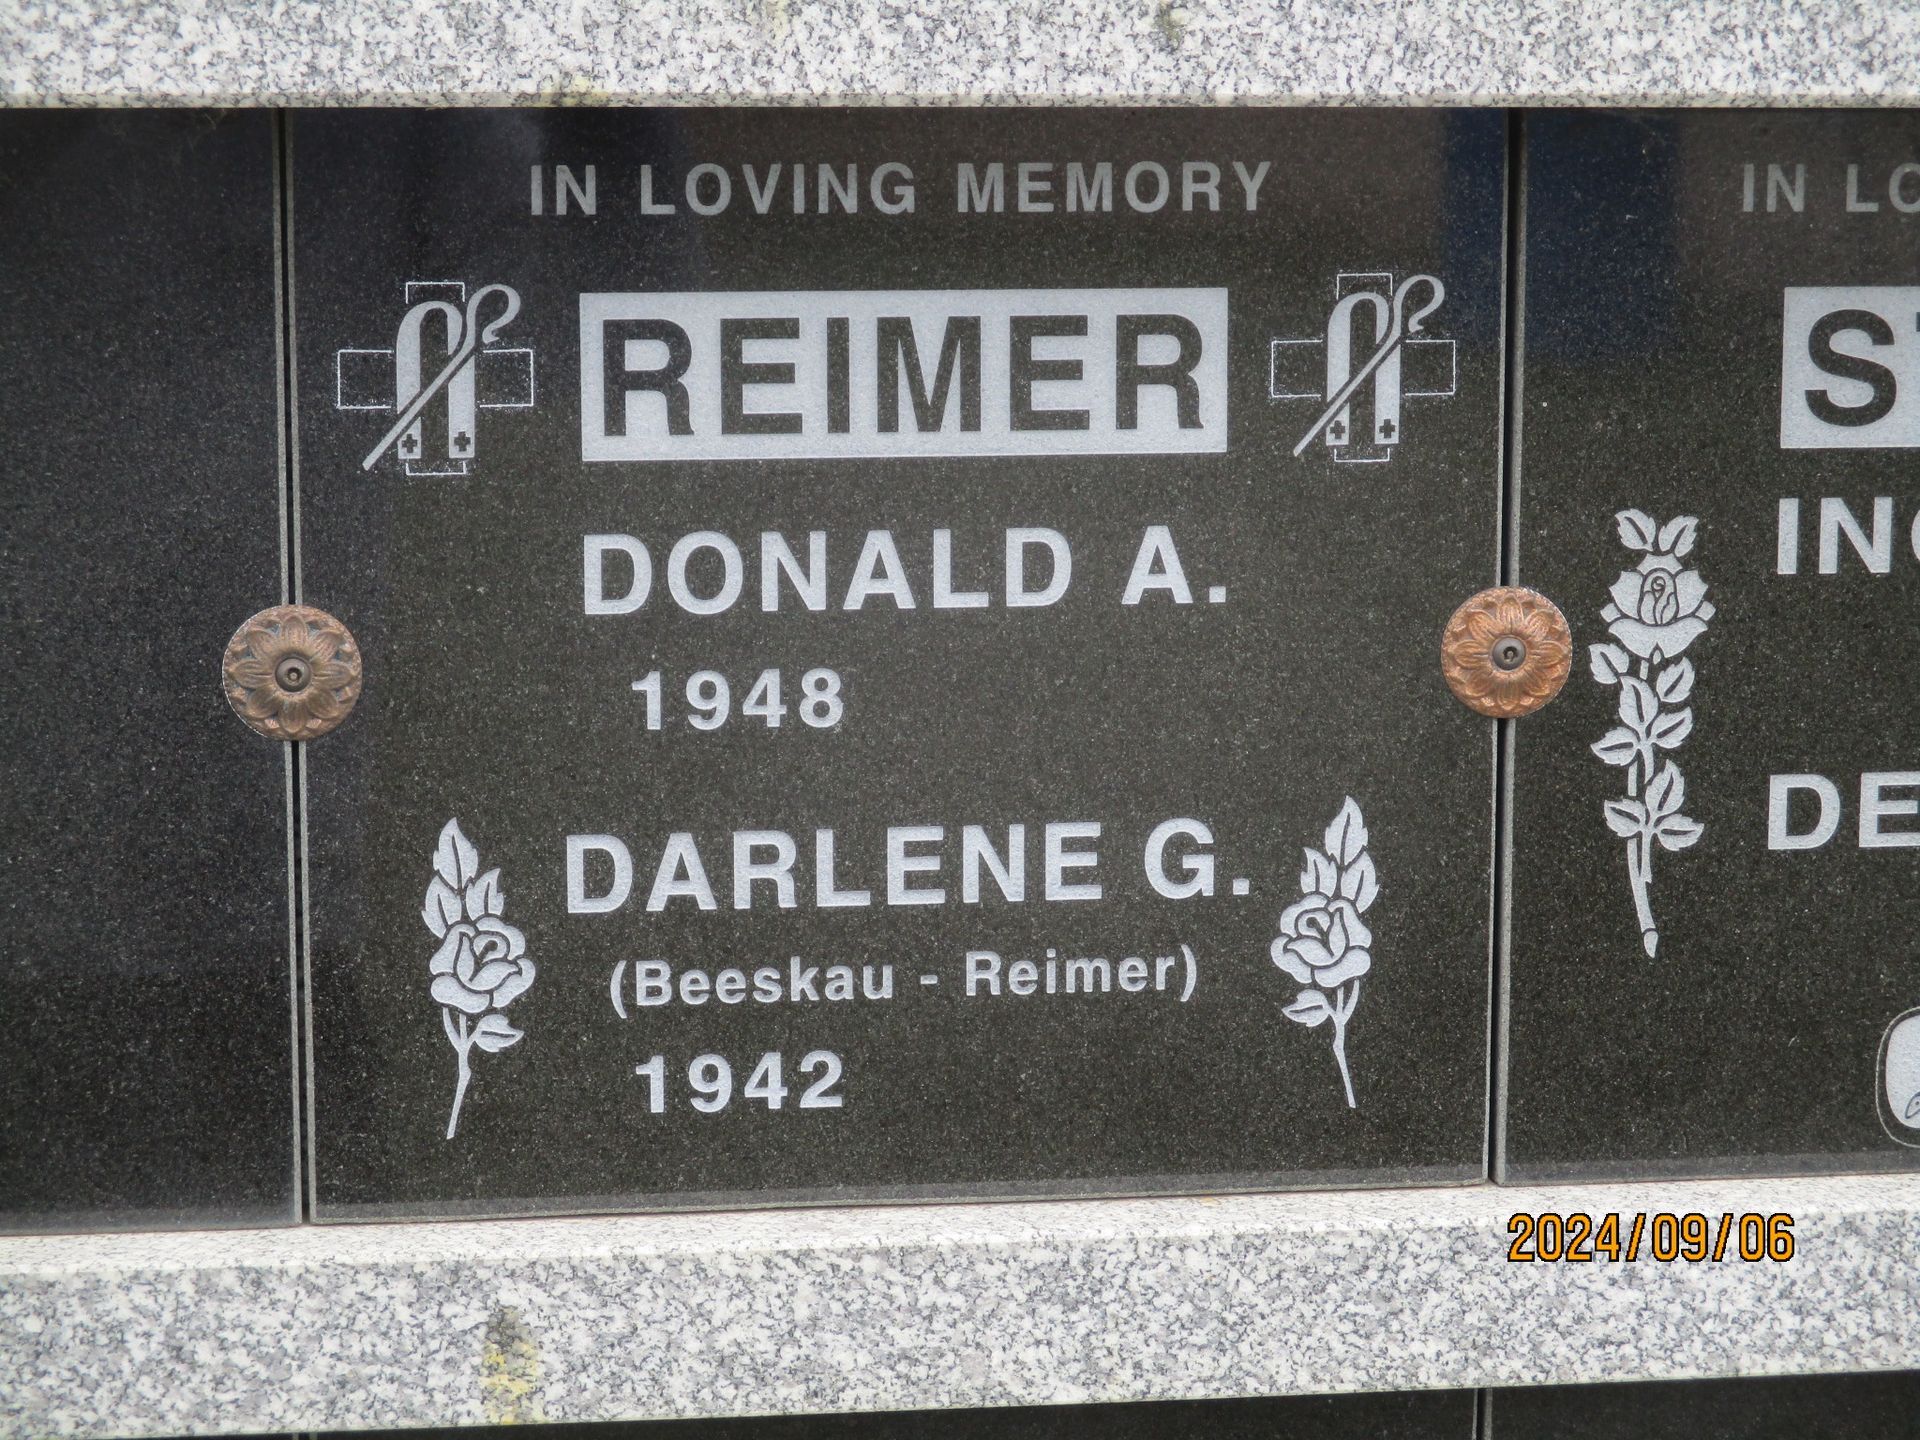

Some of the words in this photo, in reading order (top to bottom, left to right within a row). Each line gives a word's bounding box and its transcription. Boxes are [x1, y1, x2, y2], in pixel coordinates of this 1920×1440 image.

[531, 164, 597, 216] IN
[641, 161, 916, 216] LOVING
[957, 160, 1271, 214] MEMORY
[1741, 163, 1806, 213] IN
[602, 313, 1204, 437] REIMER
[1804, 309, 1920, 428] S
[583, 527, 1073, 616] DONALD
[1121, 525, 1227, 606] A.
[1776, 496, 1920, 576] IN
[631, 667, 844, 731] 1948
[1767, 771, 1920, 850] DE
[566, 821, 1103, 916] DARLENE
[1143, 817, 1250, 900] G.
[609, 956, 894, 1020] (Beeskau
[965, 944, 1198, 1003] Reimer)
[635, 1050, 843, 1114] 1942
